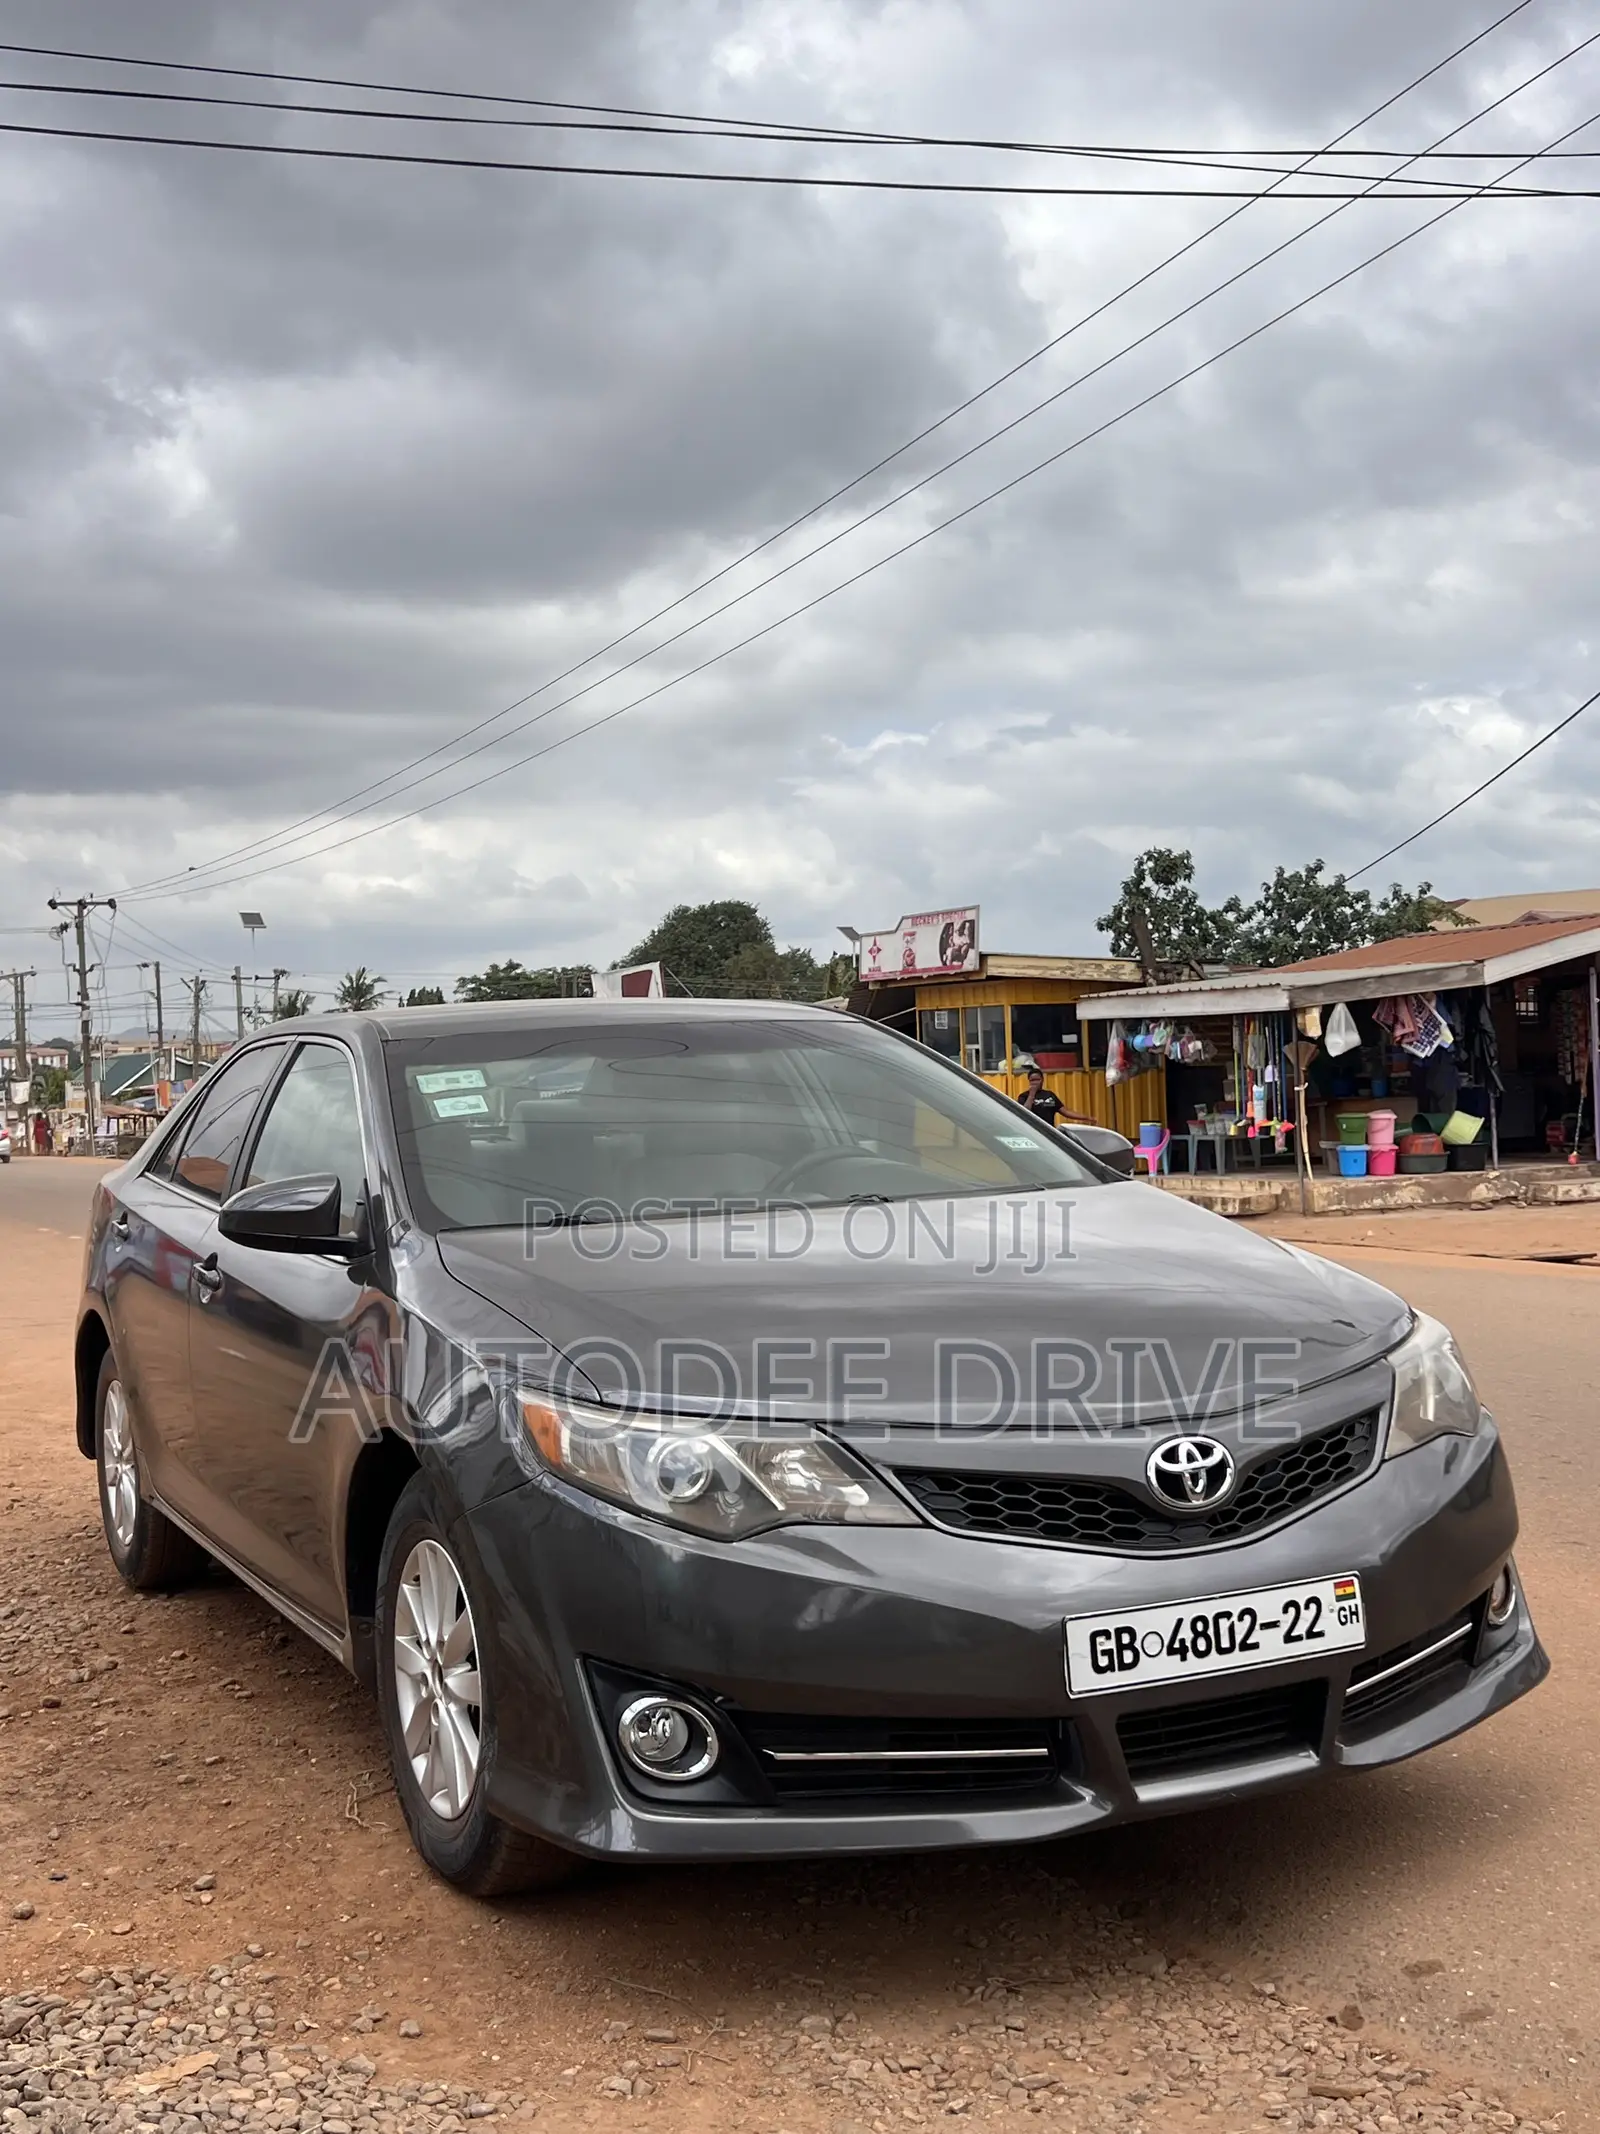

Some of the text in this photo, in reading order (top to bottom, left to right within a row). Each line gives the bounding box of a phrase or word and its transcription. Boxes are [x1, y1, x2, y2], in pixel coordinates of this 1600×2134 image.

[1089, 1596, 1326, 1675] GB 4802-22
[1337, 1603, 1360, 1627] GH
